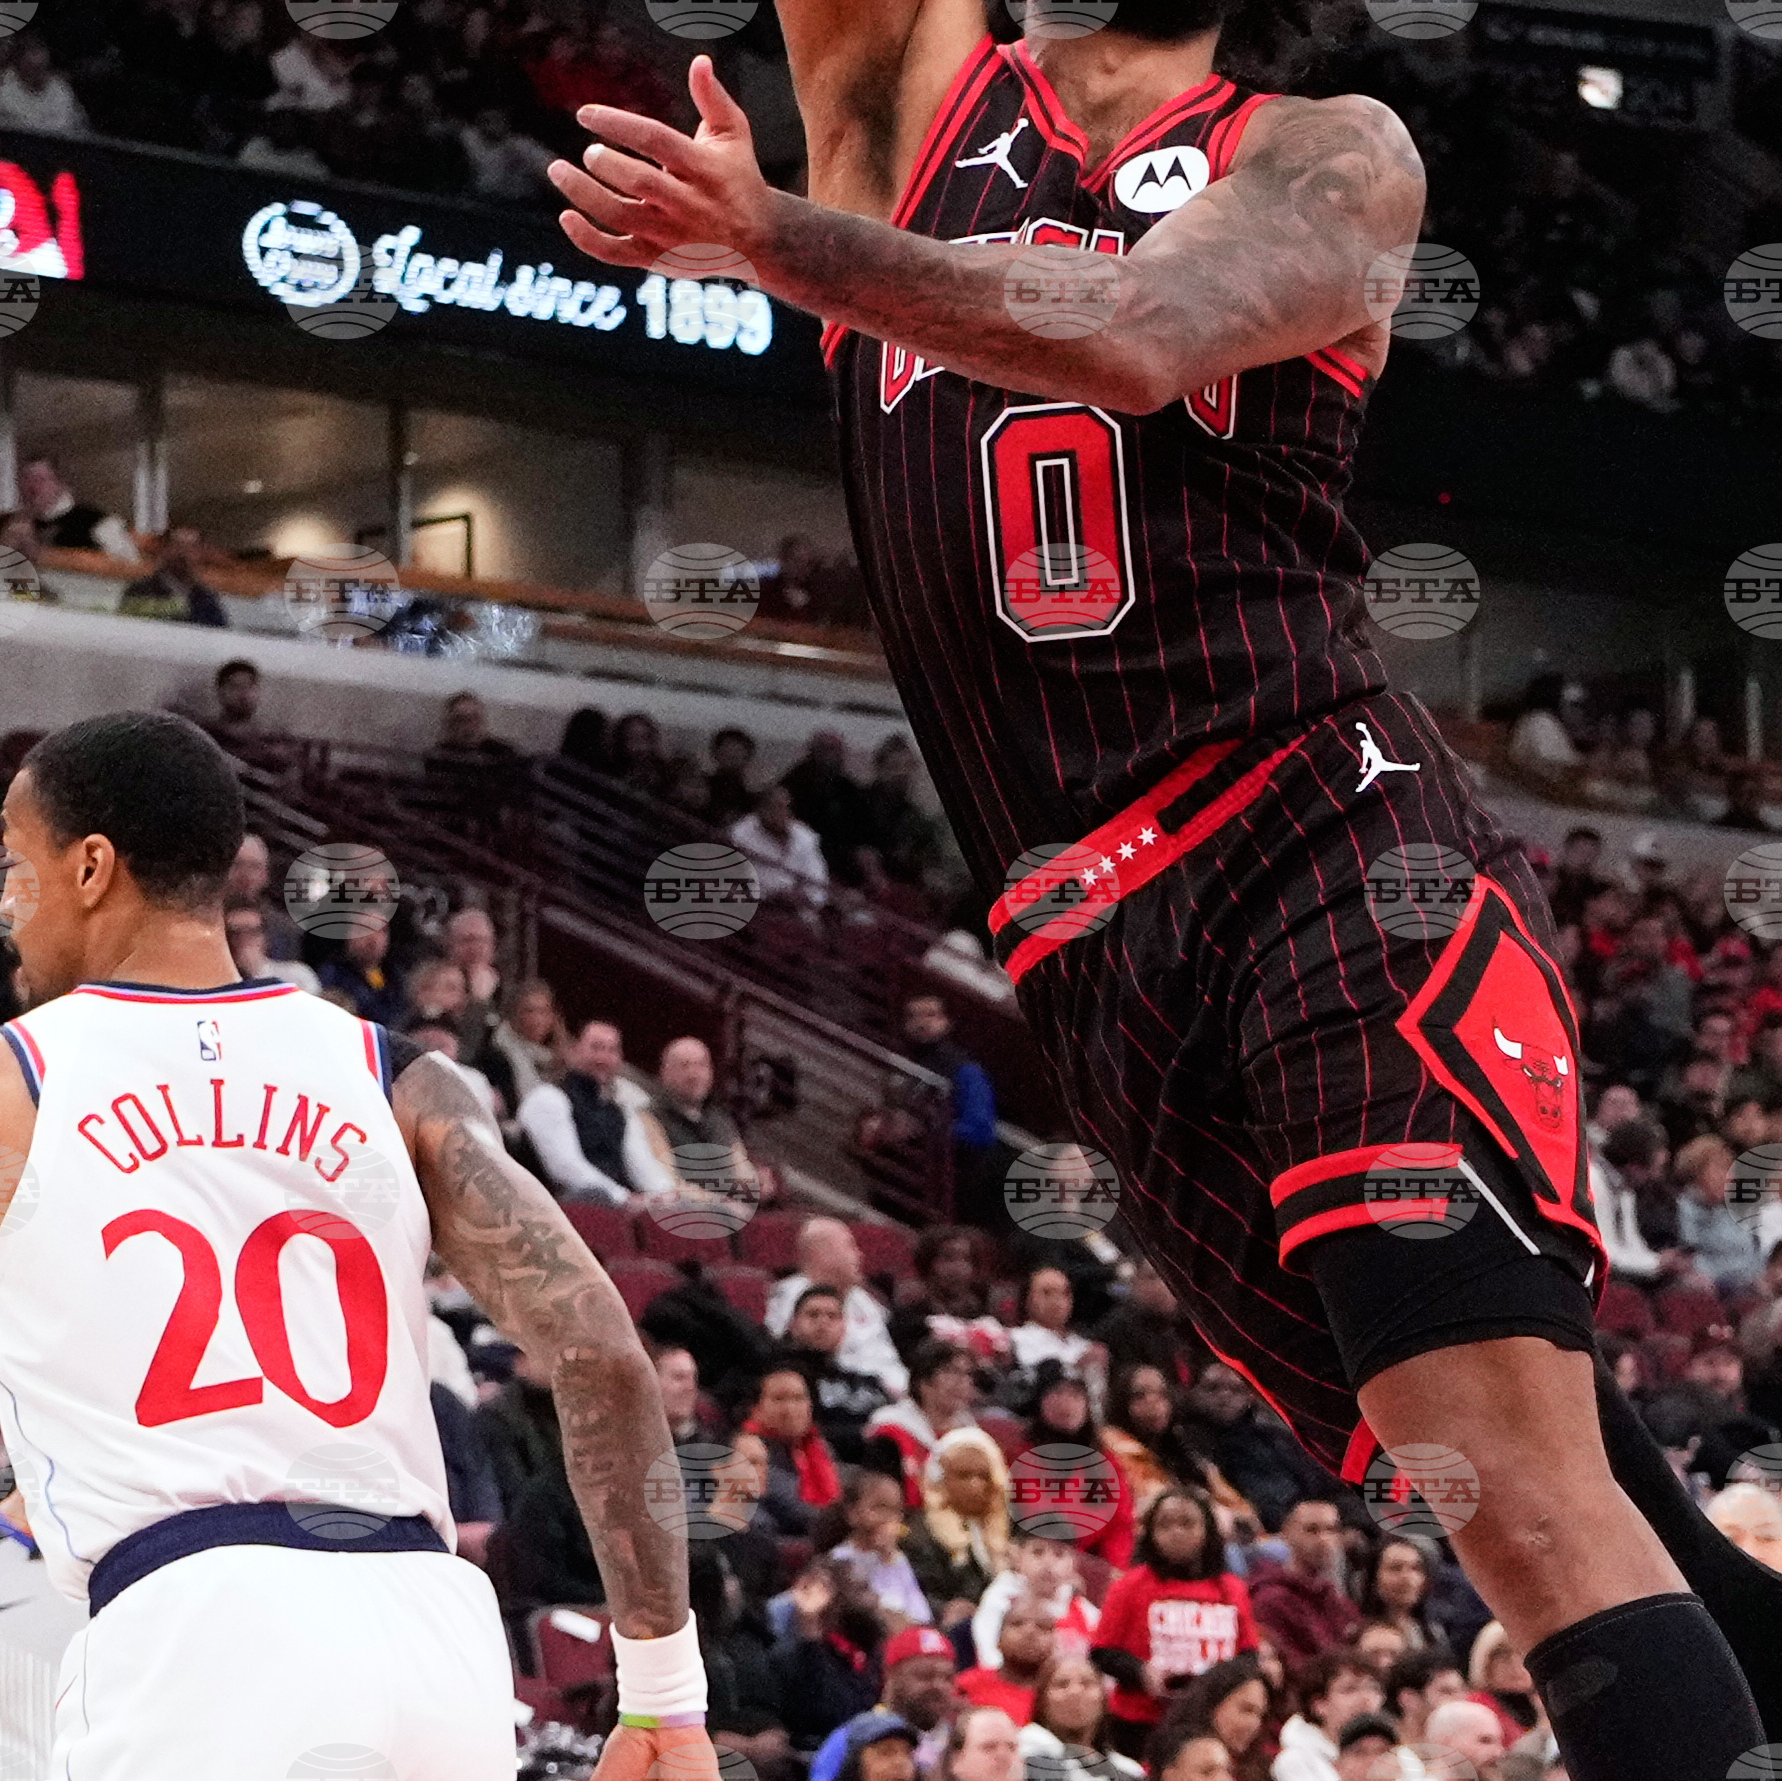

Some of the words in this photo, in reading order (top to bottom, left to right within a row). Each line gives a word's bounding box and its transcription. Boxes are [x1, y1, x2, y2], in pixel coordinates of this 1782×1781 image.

[636, 273, 773, 356] 1899
[981, 400, 1136, 642] 0
[77, 1078, 368, 1183] COLLINS
[100, 1208, 389, 1429] 20
